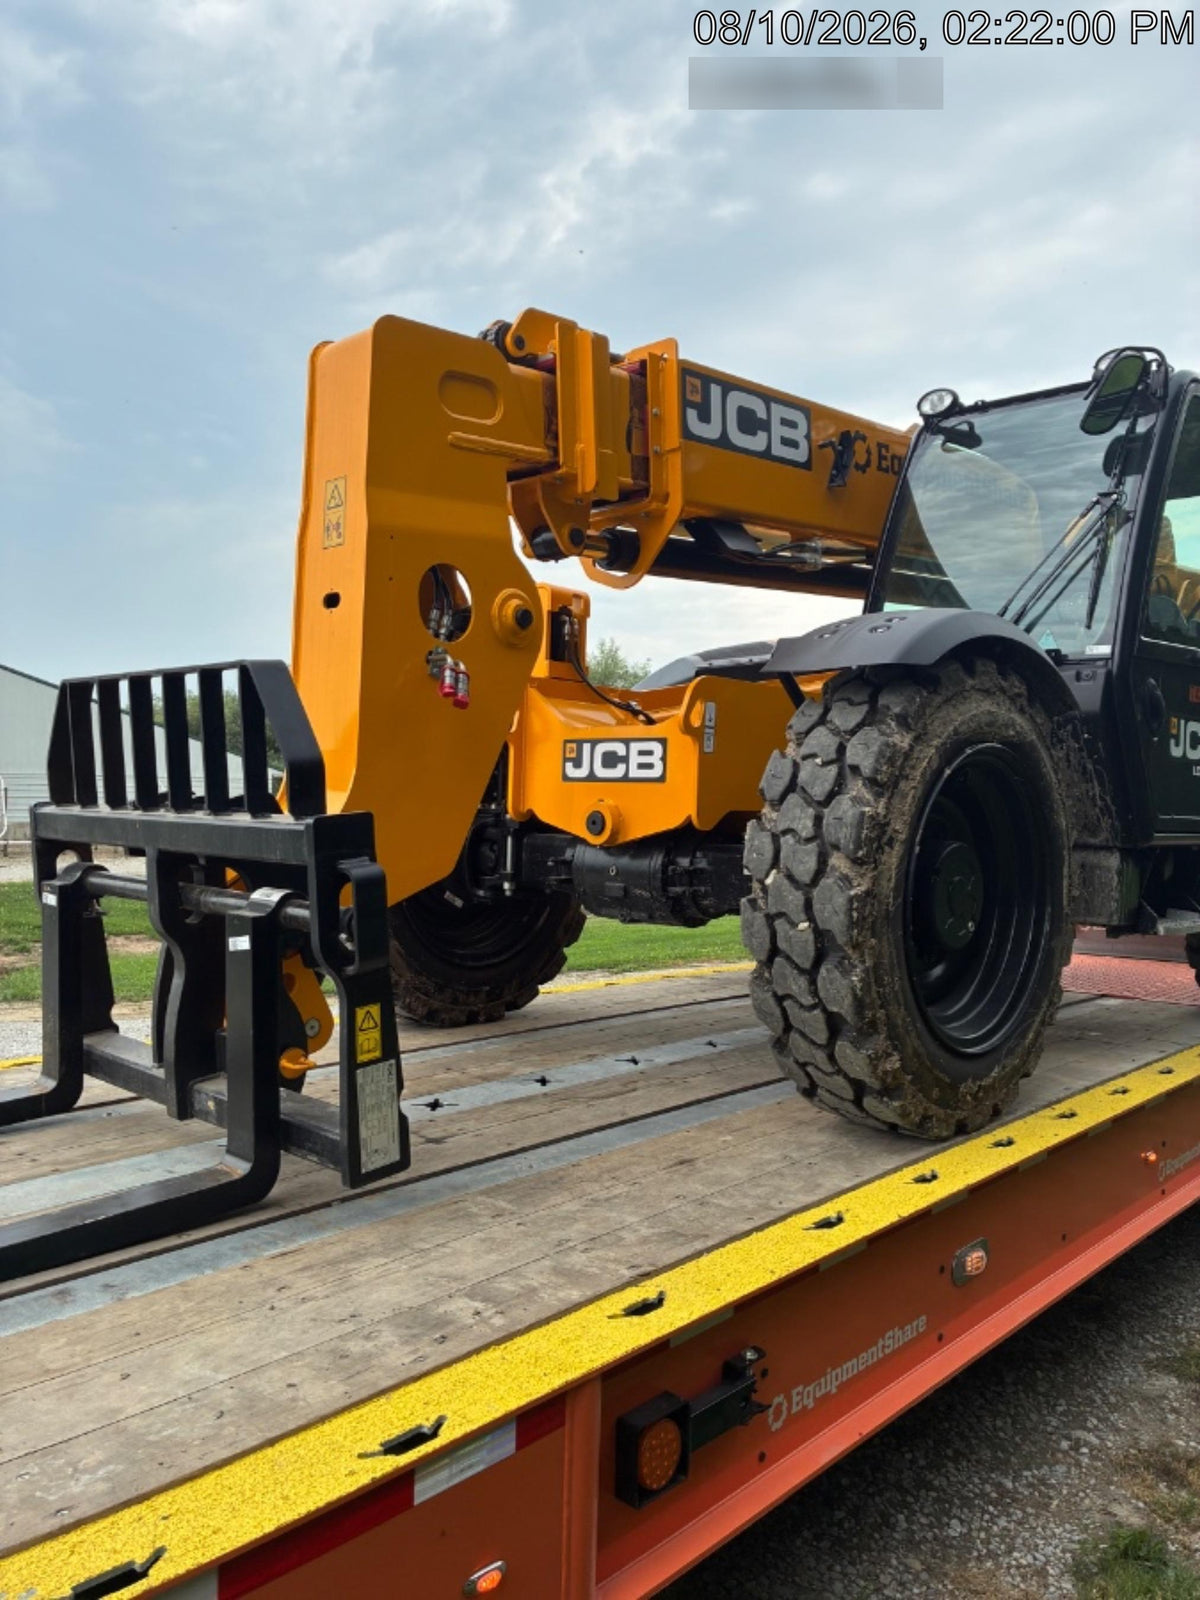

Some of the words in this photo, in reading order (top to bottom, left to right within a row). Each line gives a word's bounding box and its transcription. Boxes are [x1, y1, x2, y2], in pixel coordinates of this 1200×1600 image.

[686, 383, 809, 463] JCB
[565, 741, 664, 778] JCB
[791, 1315, 928, 1415] EquipmentShare
